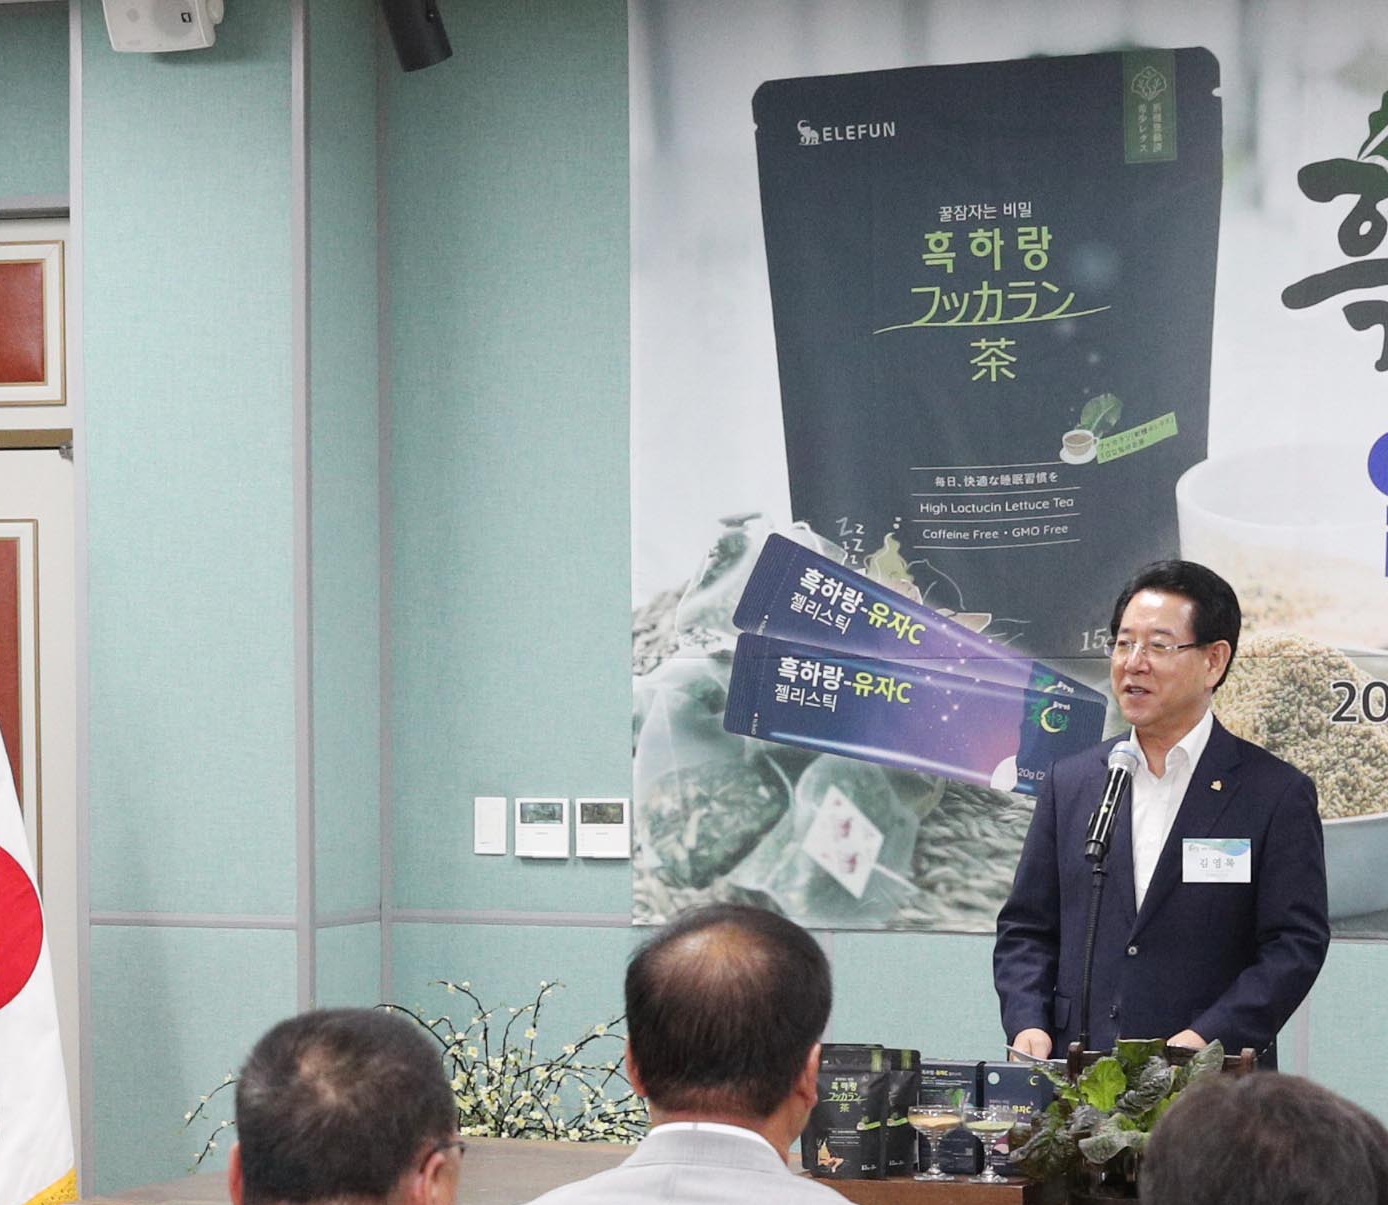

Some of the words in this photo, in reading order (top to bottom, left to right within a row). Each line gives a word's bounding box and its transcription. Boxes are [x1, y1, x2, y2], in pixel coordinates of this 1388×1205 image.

[822, 121, 896, 142] ELEFUN
[938, 203, 997, 222] 꿀잠자는
[1003, 201, 1033, 218] 비밀
[921, 225, 1053, 274] 흑하랑
[910, 280, 1076, 326] フッカラン
[969, 337, 1018, 382] 茶
[920, 503, 948, 515] High
[951, 501, 1002, 513] Lactucin
[1005, 499, 1050, 512] Lettuce
[1053, 498, 1075, 508] Tea
[922, 528, 970, 540] Caffeine
[973, 529, 999, 540] Free
[1012, 526, 1040, 538] GMO
[1043, 524, 1069, 535] Free
[790, 591, 853, 636] 젤리스틱
[799, 567, 927, 645] 흑하랑-유자C
[774, 683, 838, 713] 젤리스틱
[777, 656, 913, 704] 흑하랑-유자C
